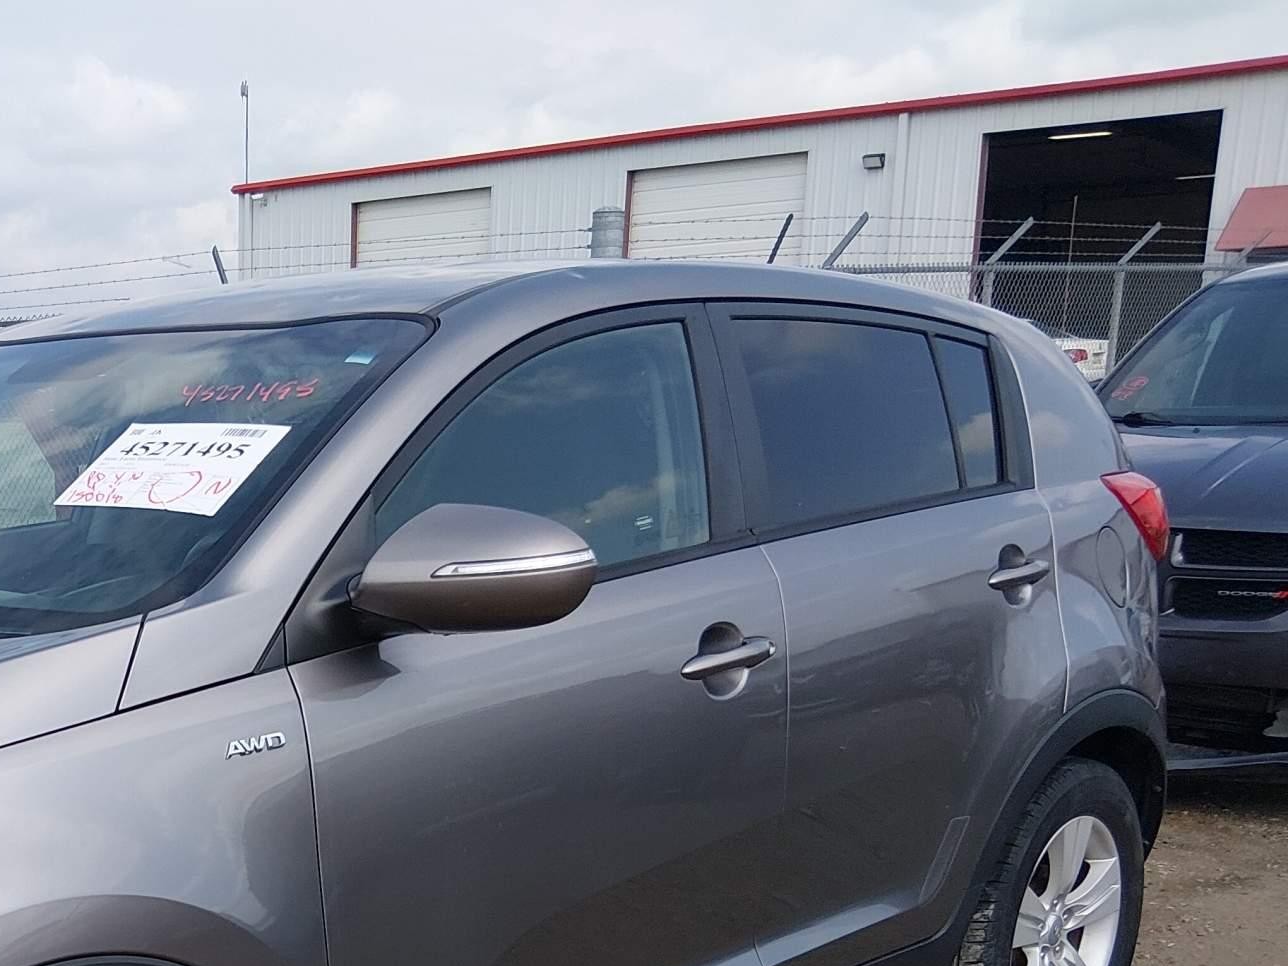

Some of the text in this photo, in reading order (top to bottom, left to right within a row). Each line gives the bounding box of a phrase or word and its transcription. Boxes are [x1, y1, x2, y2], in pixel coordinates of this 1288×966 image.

[182, 378, 319, 407] 45271495
[120, 441, 252, 459] 45271495
[225, 731, 286, 760] AWD
